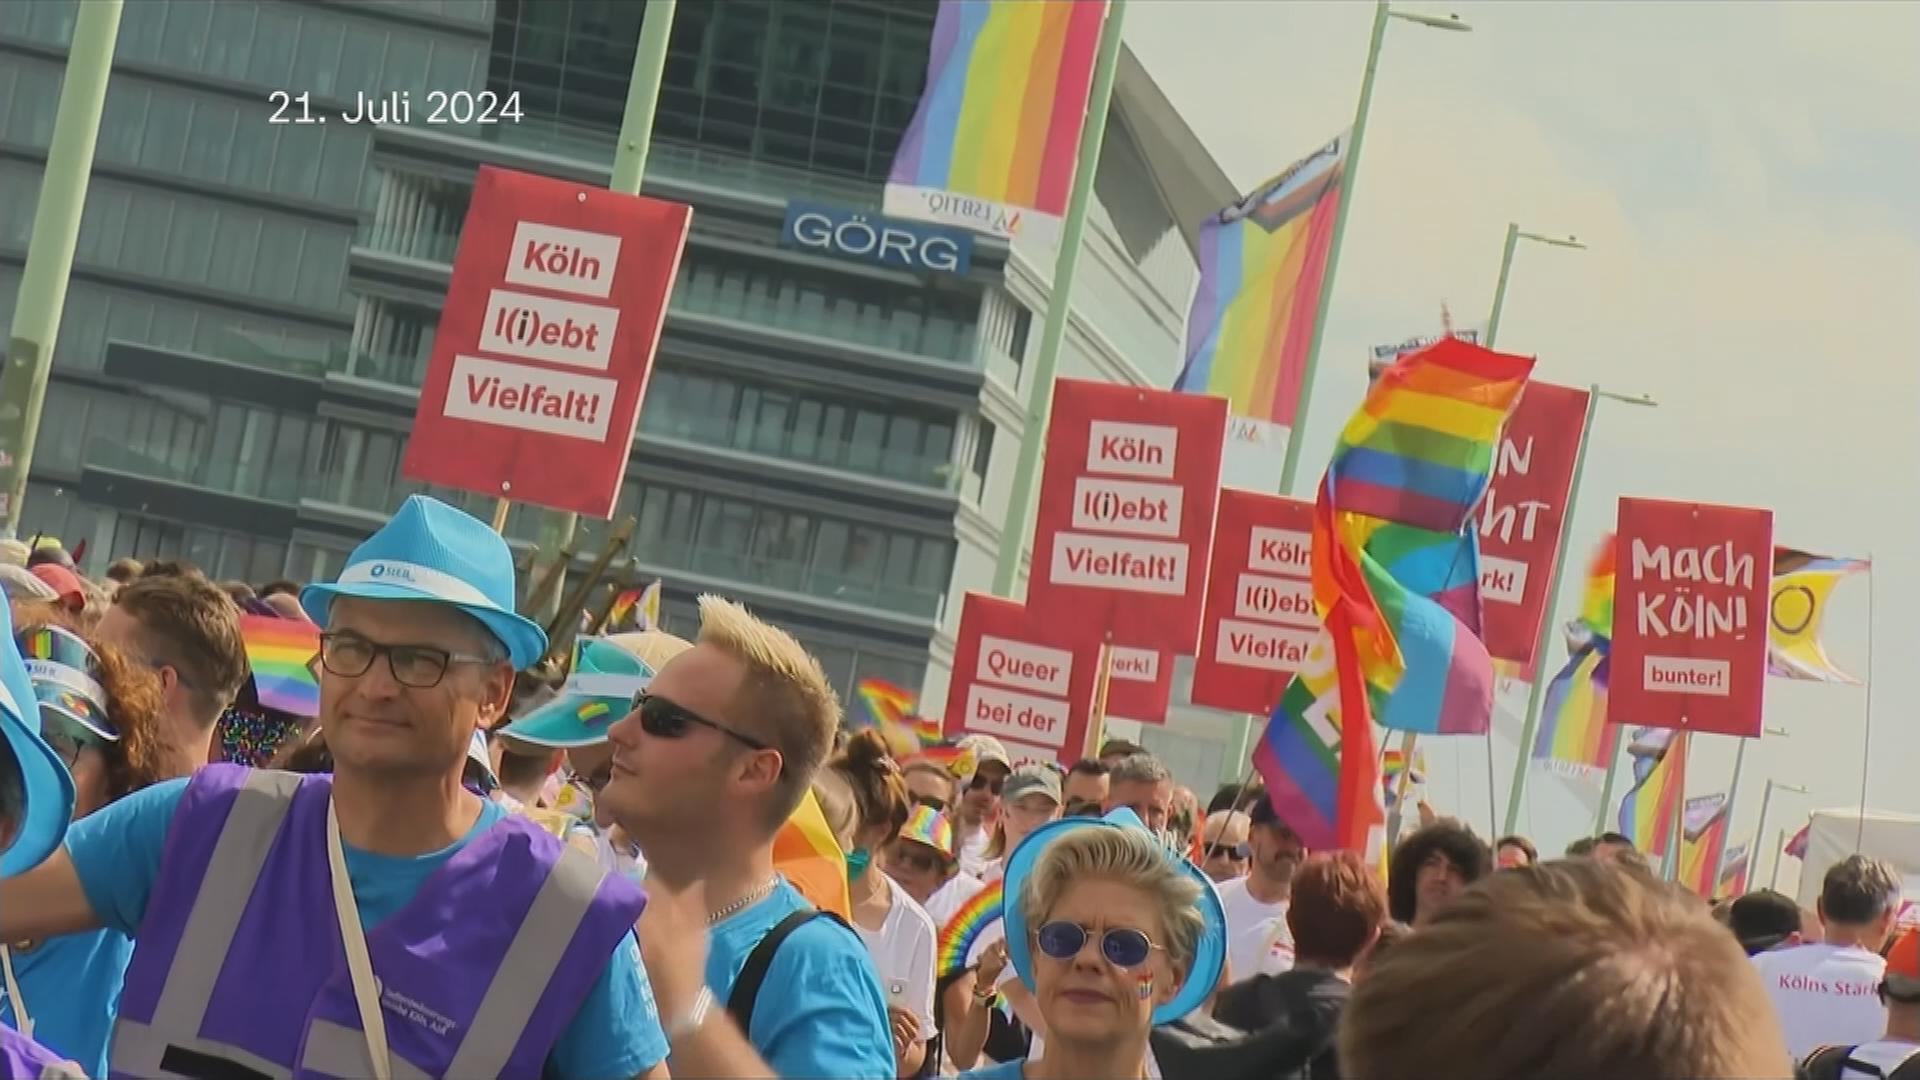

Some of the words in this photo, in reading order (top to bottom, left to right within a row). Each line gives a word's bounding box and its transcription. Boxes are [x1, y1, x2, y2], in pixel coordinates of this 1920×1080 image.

[793, 212, 959, 272] GÖRG
[523, 240, 600, 280] Köln
[495, 307, 599, 352] l(i)ebt
[467, 373, 600, 425] Vielfalt!
[1101, 435, 1163, 464] Köln
[1084, 491, 1168, 523] l(i)ebt
[1066, 547, 1176, 582] Vielfalt!
[1482, 569, 1514, 592] rk!
[1632, 537, 1754, 590] Mach
[1230, 632, 1308, 662] Vielfal
[988, 649, 1060, 682] Queer
[1652, 665, 1722, 687] bunter!
[976, 697, 1013, 724] bei
[1017, 706, 1056, 732] der
[1779, 975, 1828, 993] Kölns
[1834, 979, 1880, 998] Stärk
